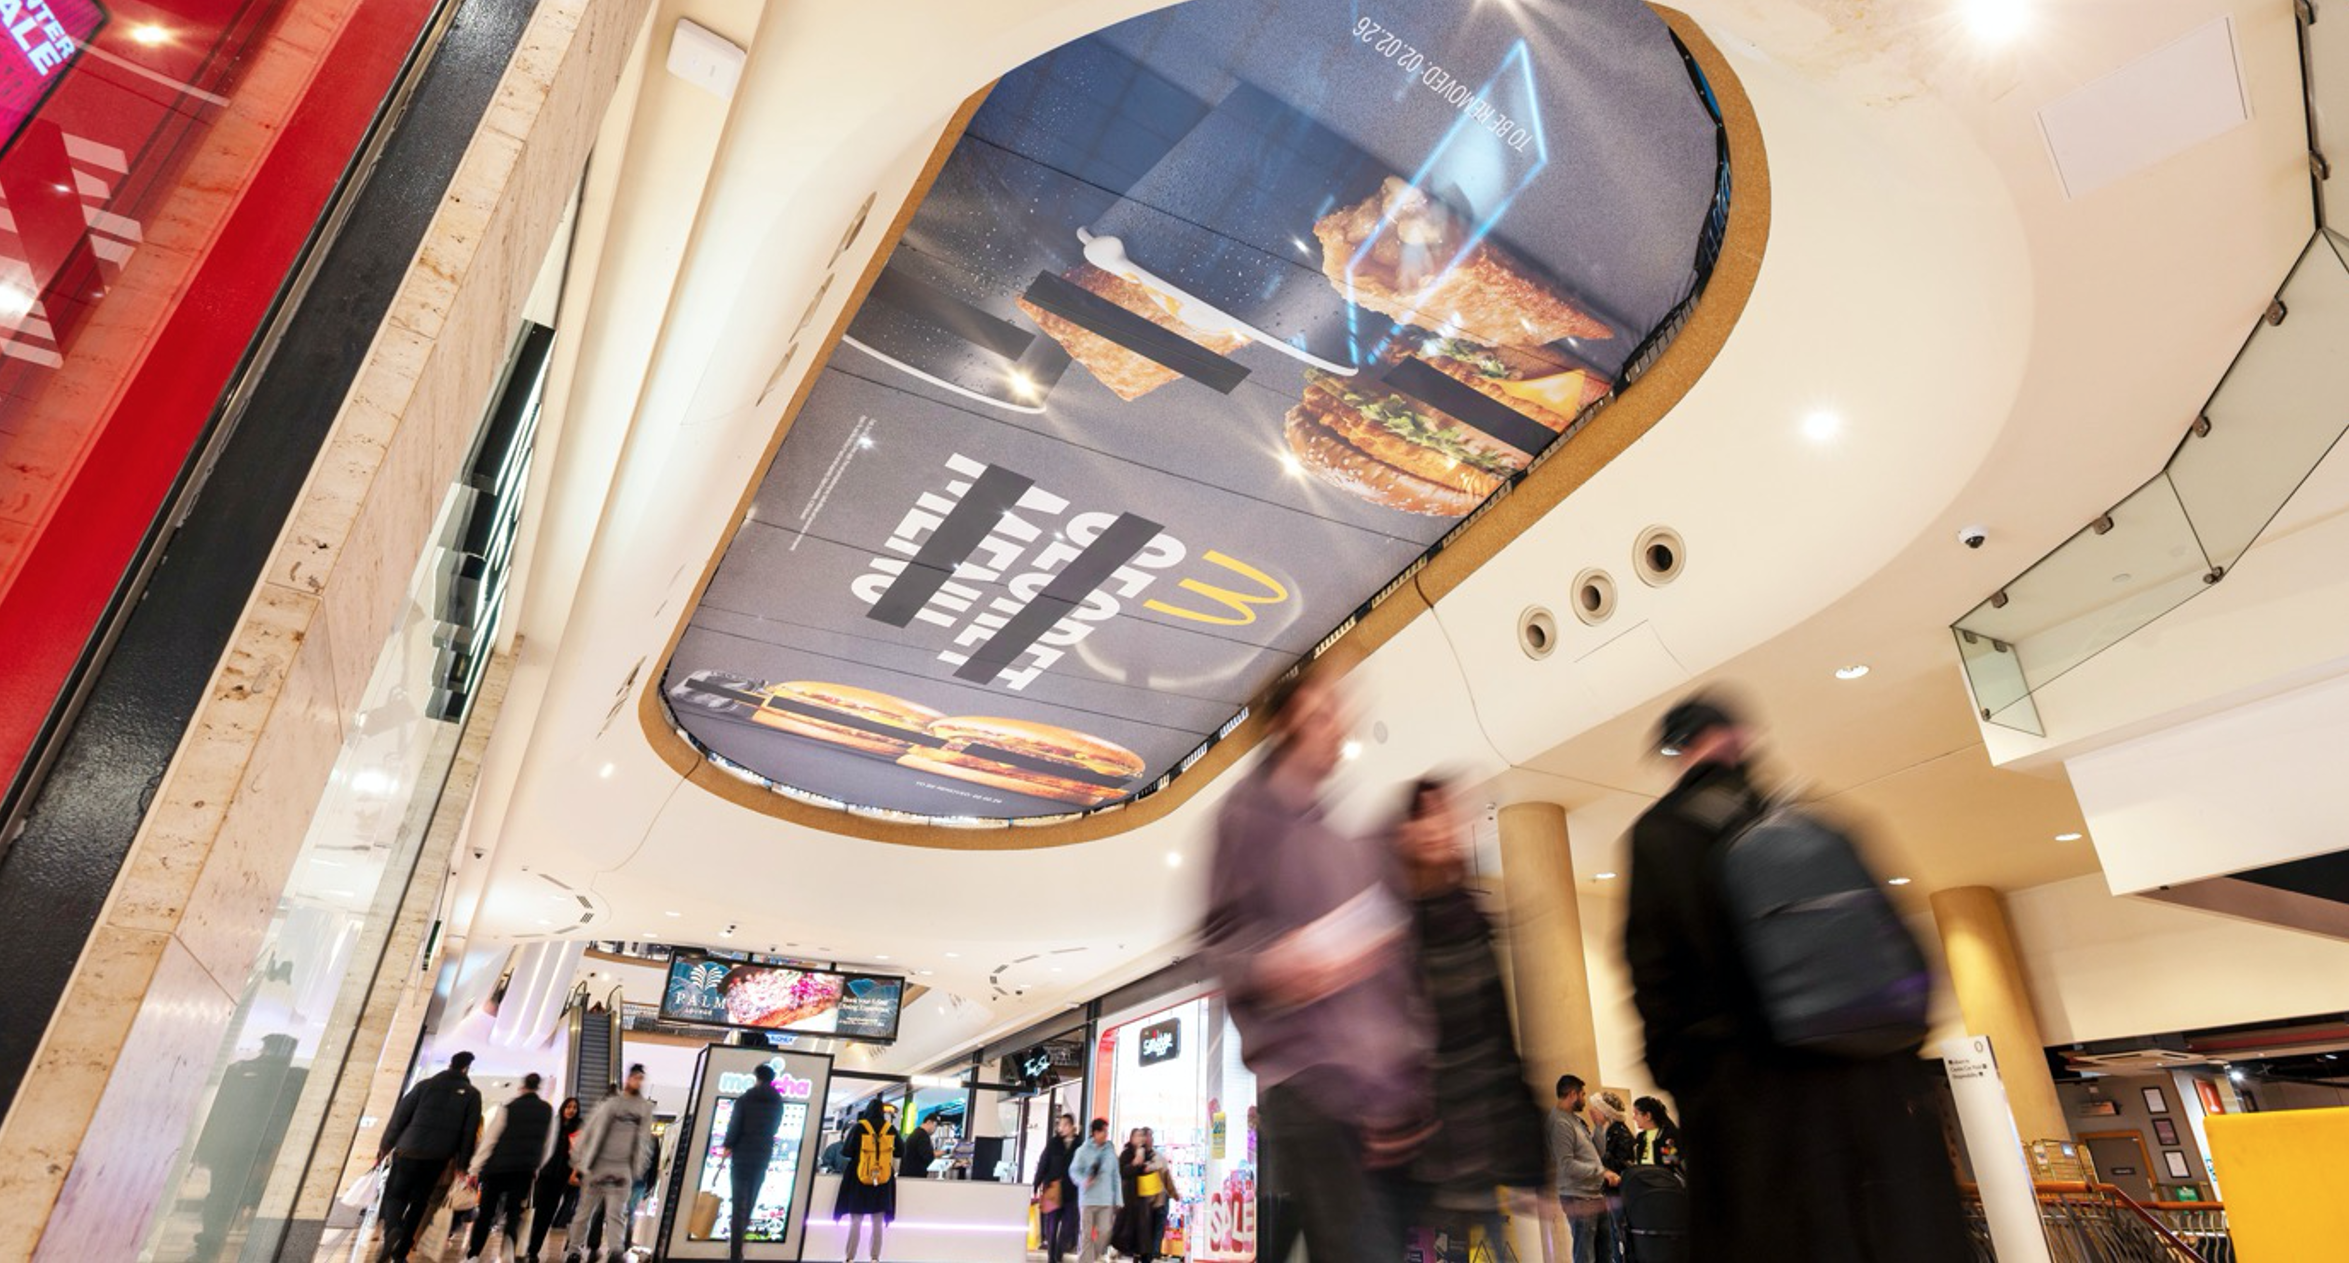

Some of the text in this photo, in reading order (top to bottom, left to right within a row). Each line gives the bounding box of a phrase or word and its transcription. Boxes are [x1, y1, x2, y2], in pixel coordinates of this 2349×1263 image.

[1352, 16, 1533, 153] TO BE REMOVED: 02.02.26
[851, 453, 1070, 628] MENU
[937, 511, 1187, 690] SECRET
[674, 992, 727, 1009] PALM
[1210, 1199, 1254, 1245] SALE
